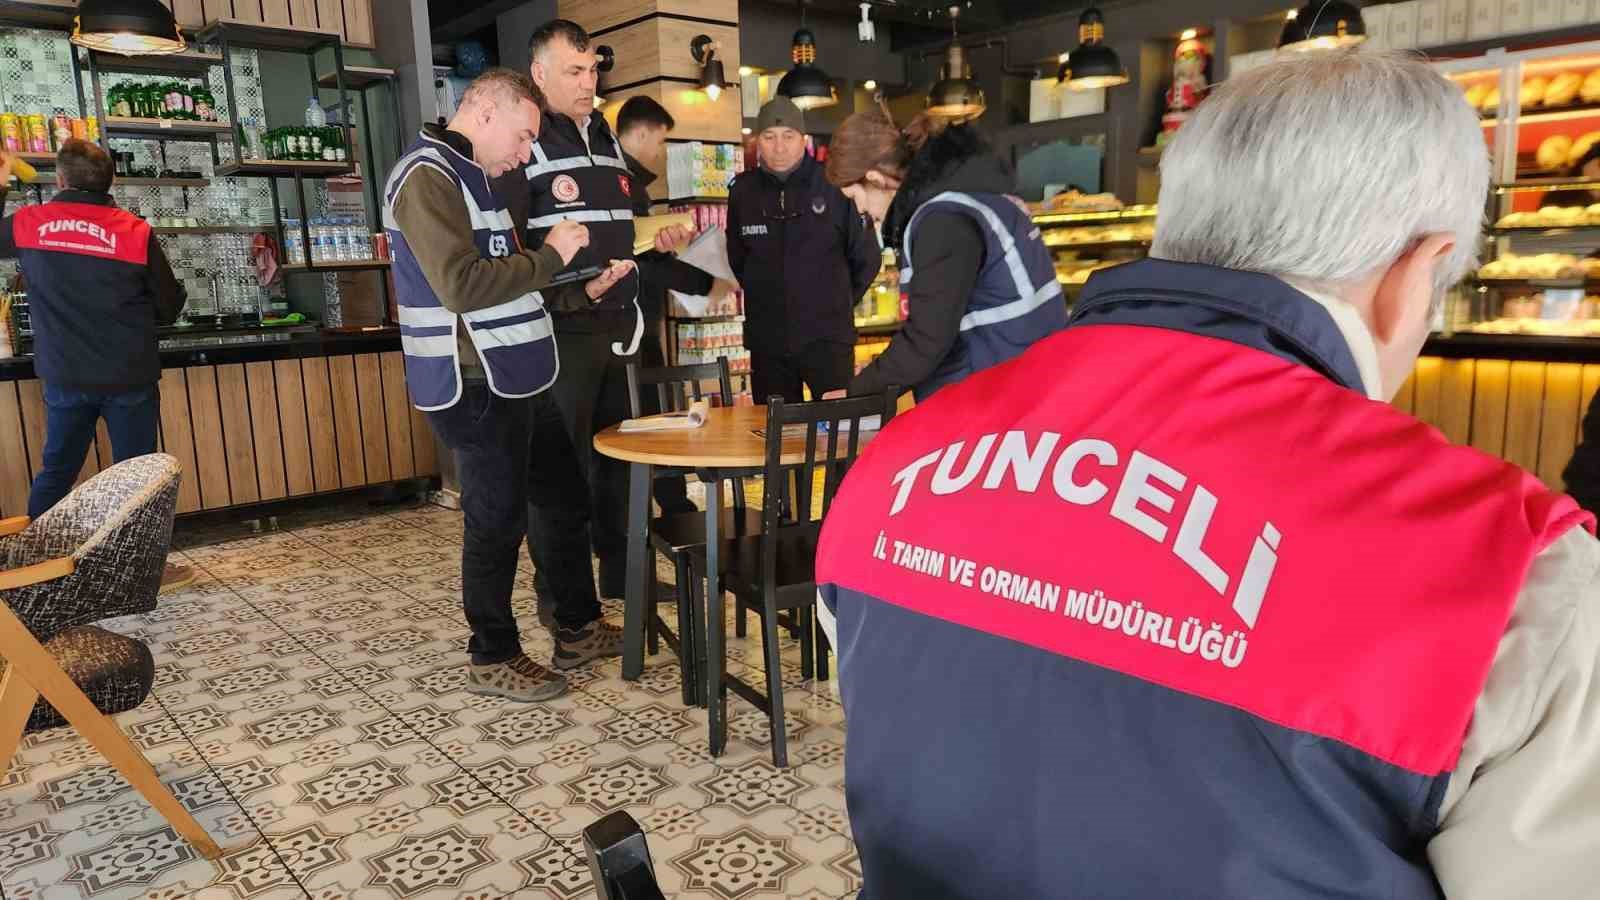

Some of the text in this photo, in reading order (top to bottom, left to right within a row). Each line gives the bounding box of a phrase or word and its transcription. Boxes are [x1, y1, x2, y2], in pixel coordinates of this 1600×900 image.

[872, 529, 1248, 669] İL TARIM VE ORMAN MÜDÜRLÜĞÜ
[889, 430, 1282, 630] TUNCELİ
